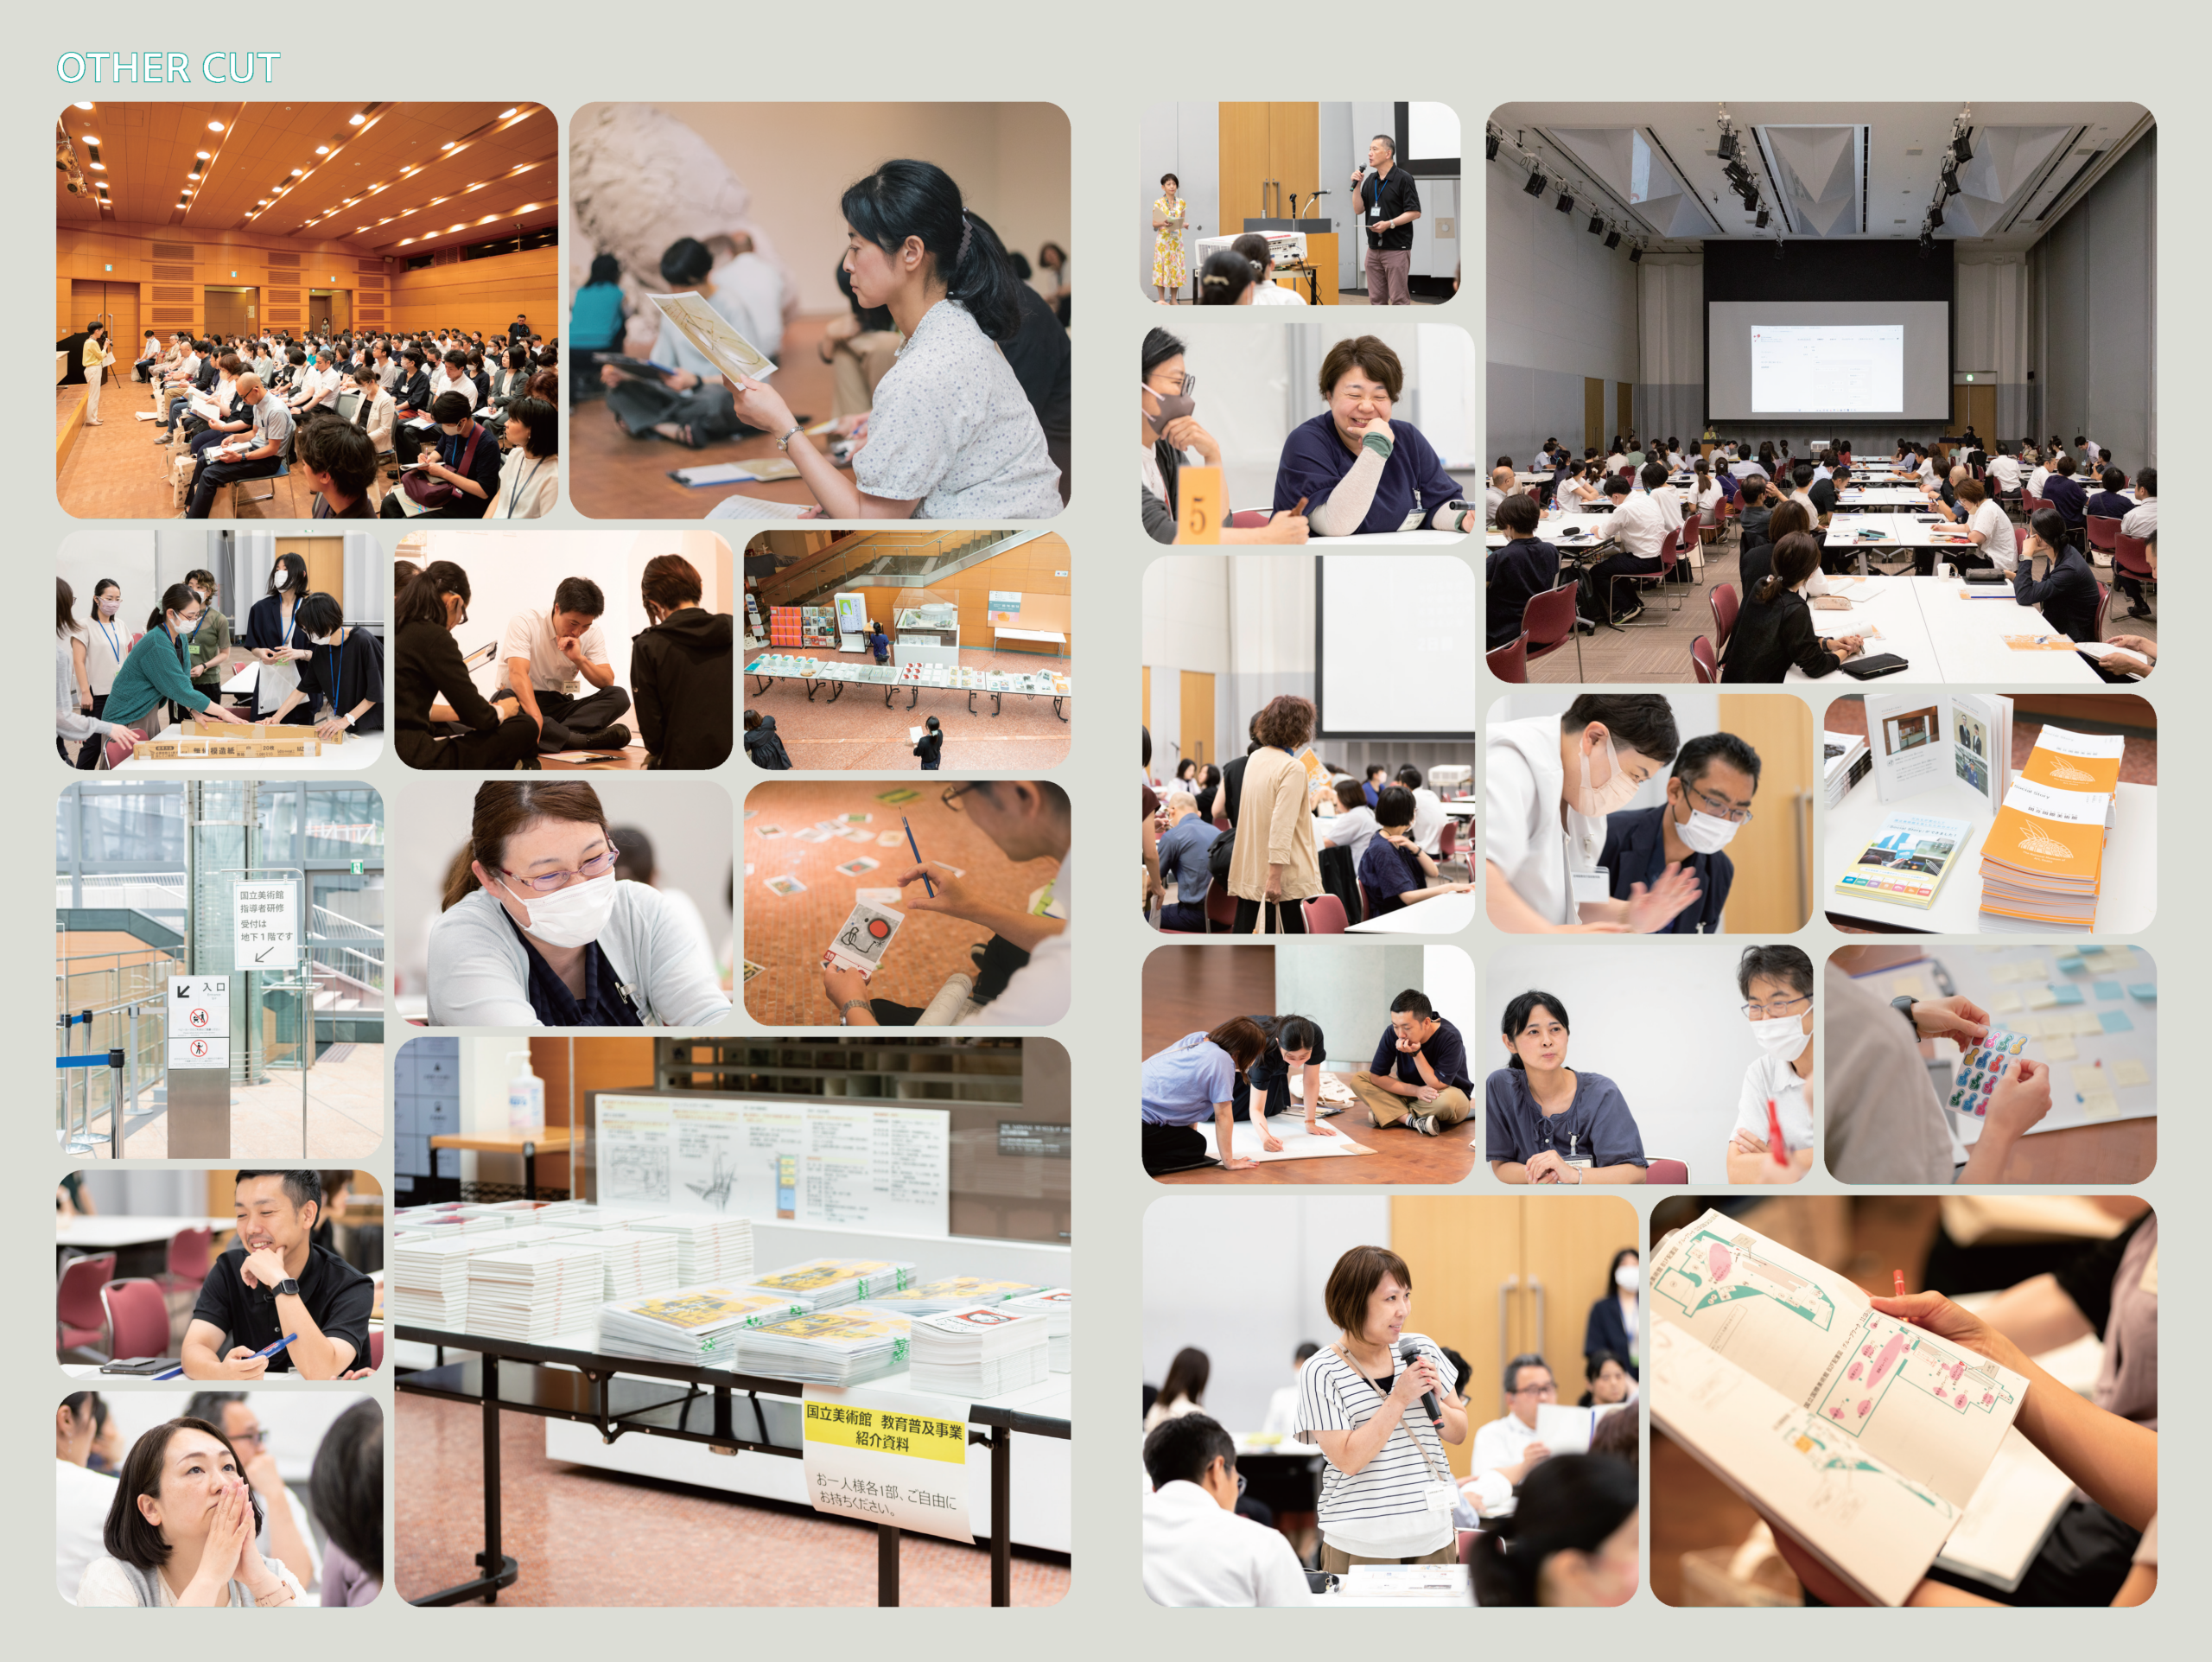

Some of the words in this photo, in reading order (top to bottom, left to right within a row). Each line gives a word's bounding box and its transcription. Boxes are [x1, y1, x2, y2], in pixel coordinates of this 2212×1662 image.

[1189, 497, 1206, 535] 5
[240, 890, 284, 900] 国立美術館
[240, 904, 284, 914] 指導者研修
[241, 920, 267, 929] 受付は
[202, 983, 226, 992] 入口
[807, 1404, 873, 1427] 国立美術館
[880, 1414, 963, 1441] 教育普及事業
[855, 1430, 910, 1453] 紹介資料
[819, 1490, 895, 1518] お持ちください。
